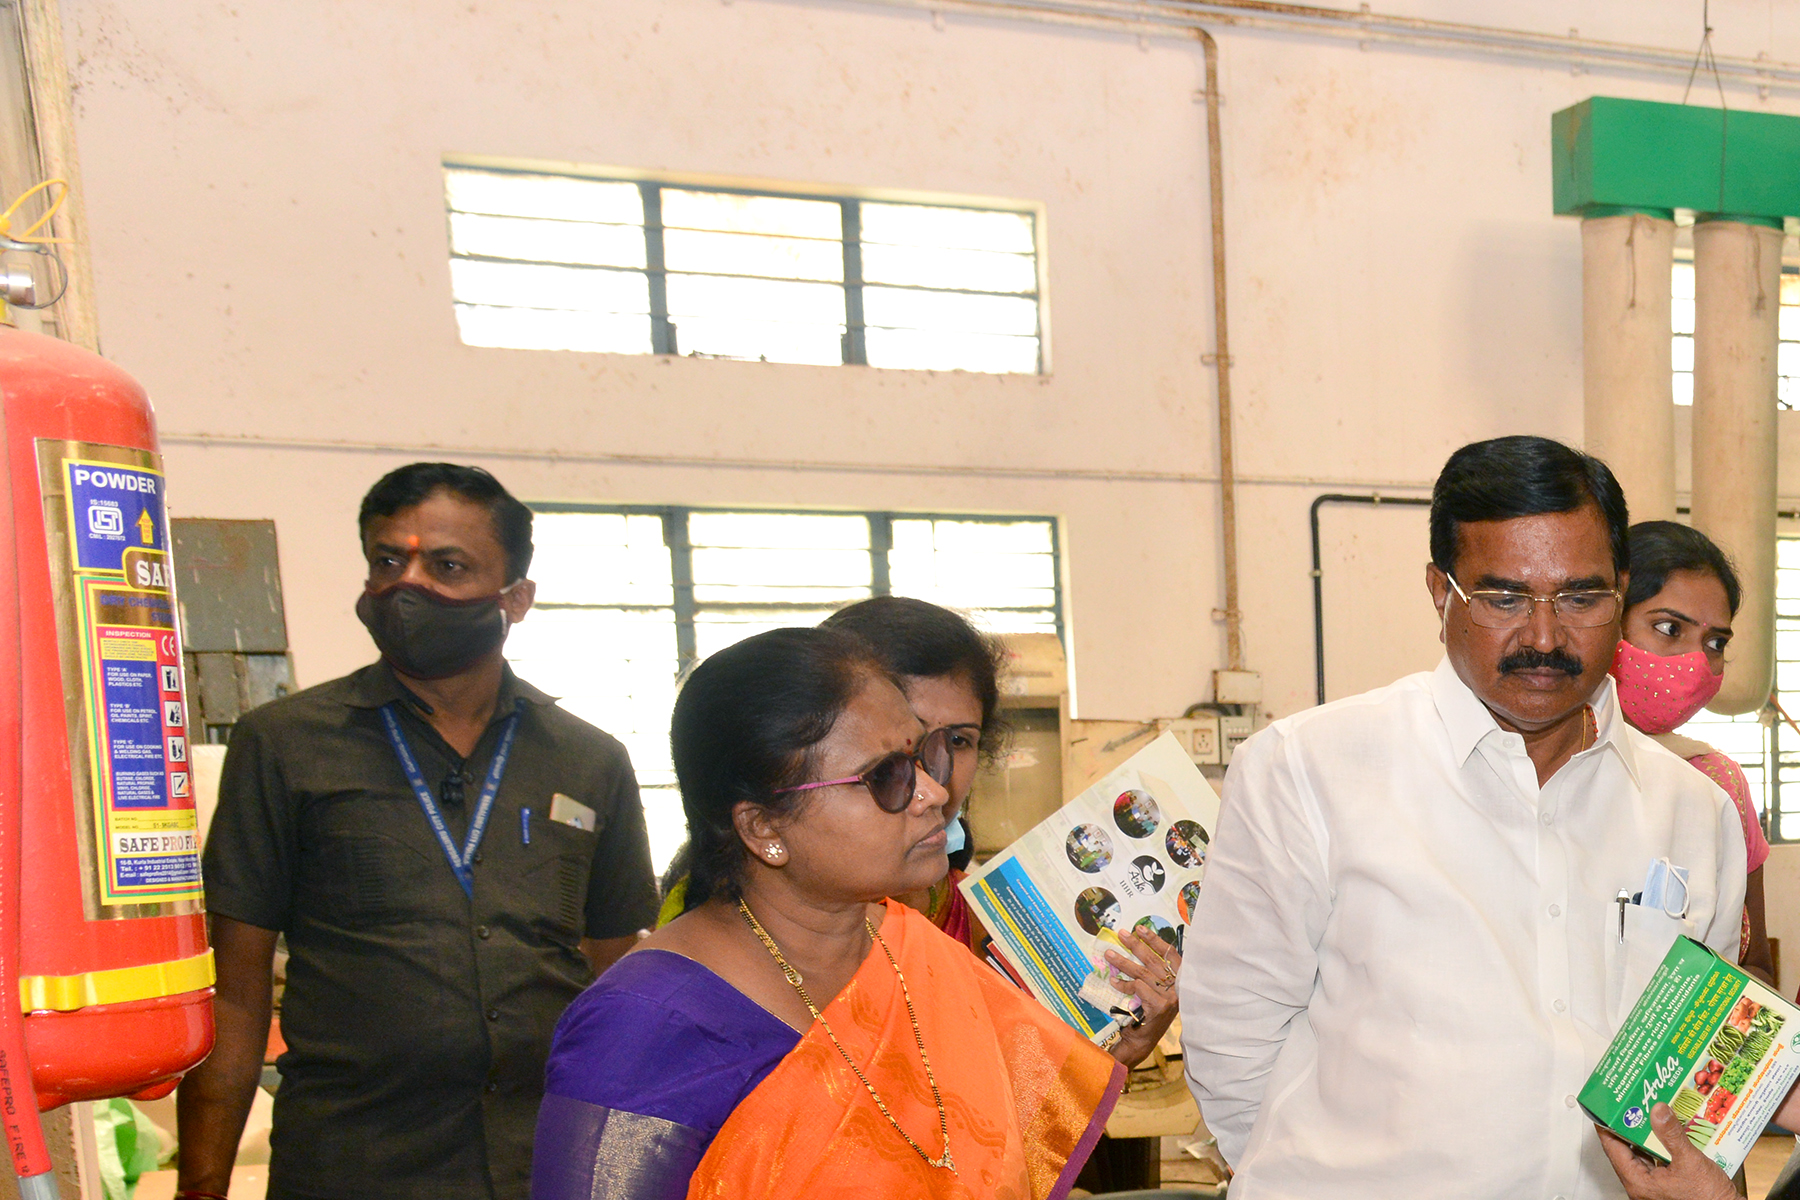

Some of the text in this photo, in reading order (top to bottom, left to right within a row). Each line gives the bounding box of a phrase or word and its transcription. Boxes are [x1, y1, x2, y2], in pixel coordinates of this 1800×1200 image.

[75, 469, 156, 494] POWDER
[136, 560, 170, 587] SAF
[105, 630, 151, 638] INSPECTION
[119, 837, 159, 853] SAFE
[162, 836, 184, 851] PRO
[418, 789, 463, 868] BENGALURU CITY POLICE
[1117, 878, 1135, 899] IIHR
[1611, 972, 1694, 1095] Vegetables are rich in Vitamins,
[1686, 978, 1742, 1060] VEGETABLE SEED KIT FOR NUTRITIONAL SECURITY
[1614, 1065, 1642, 1103] Minerals,
[1638, 1039, 1658, 1066] Fibres
[1655, 1022, 1669, 1040] and
[1665, 972, 1701, 1024] Antioxidants
[1641, 1055, 1680, 1112] Arka
[1667, 1065, 1684, 1087] SEEDS
[10, 1124, 27, 1161] FIRE
